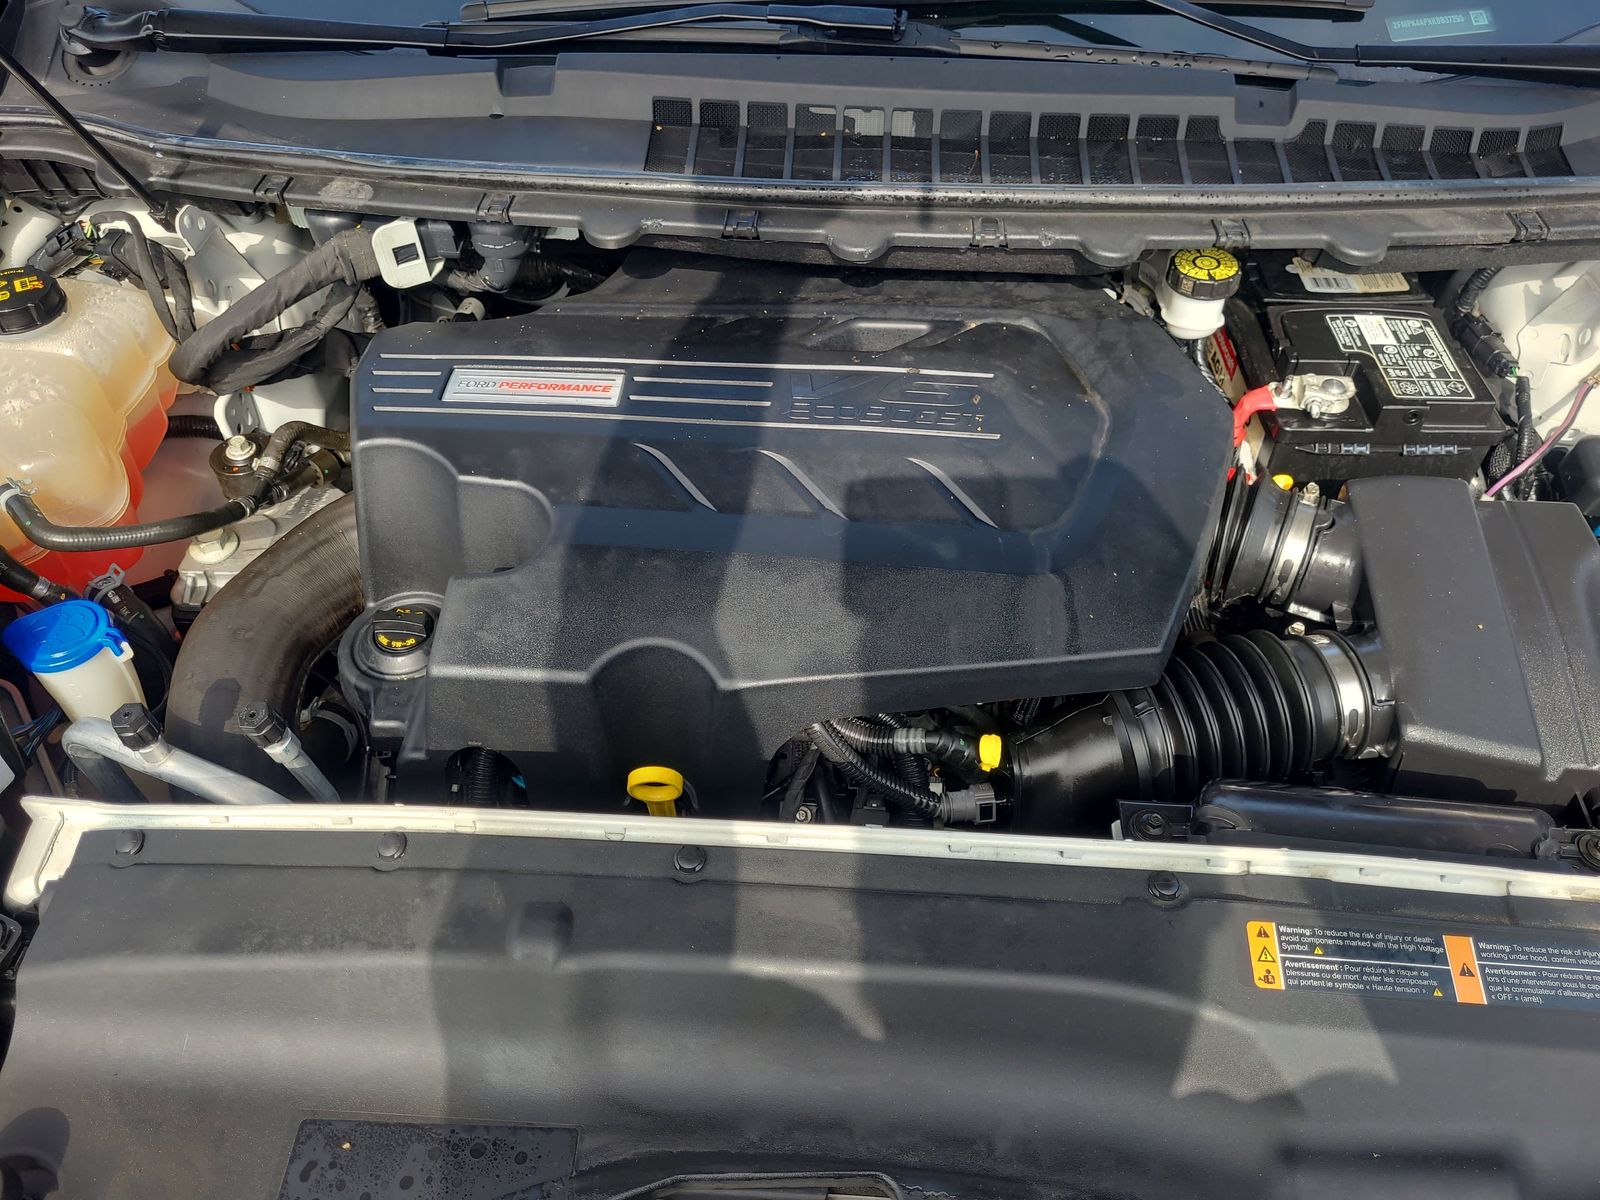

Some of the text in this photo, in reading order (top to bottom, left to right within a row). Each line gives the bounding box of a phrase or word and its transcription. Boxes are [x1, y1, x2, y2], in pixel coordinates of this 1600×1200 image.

[458, 380, 613, 393] FORD PERFORMANCE
[789, 402, 985, 426] ECOBOOST
[1279, 926, 1312, 935] Warning:
[1324, 930, 1348, 938] reduce
[1349, 931, 1360, 939] the
[1384, 933, 1402, 942] injury
[1280, 934, 1444, 954] avoid components marked with the High Voltage
[1281, 942, 1310, 952] Symbol.
[1478, 942, 1512, 953] Warning:
[1513, 944, 1521, 952] To
[1523, 945, 1547, 953] reduce
[1481, 952, 1508, 961] working
[1509, 953, 1529, 961] under
[1551, 956, 1577, 964] confirm
[1284, 960, 1339, 971] Avertissement
[1344, 965, 1361, 973] Pour
[1363, 966, 1387, 975] réduire
[1397, 969, 1418, 977] risque
[1485, 967, 1536, 977] Avertissement
[1542, 971, 1559, 979] Pour
[1560, 972, 1584, 980] réduire
[1286, 969, 1320, 978] blessures
[1396, 977, 1438, 987] composants
[1501, 977, 1521, 985] d'une
[1522, 978, 1561, 987] intervention
[1287, 978, 1299, 986] qui
[1300, 979, 1325, 987] portent
[1334, 981, 1364, 990] symbole
[1372, 984, 1393, 993] Haute
[1394, 986, 1420, 994] tension
[1511, 986, 1556, 996] commutateur
[1557, 988, 1594, 999] d'allumage
[1521, 995, 1544, 1004] (arrêt).
